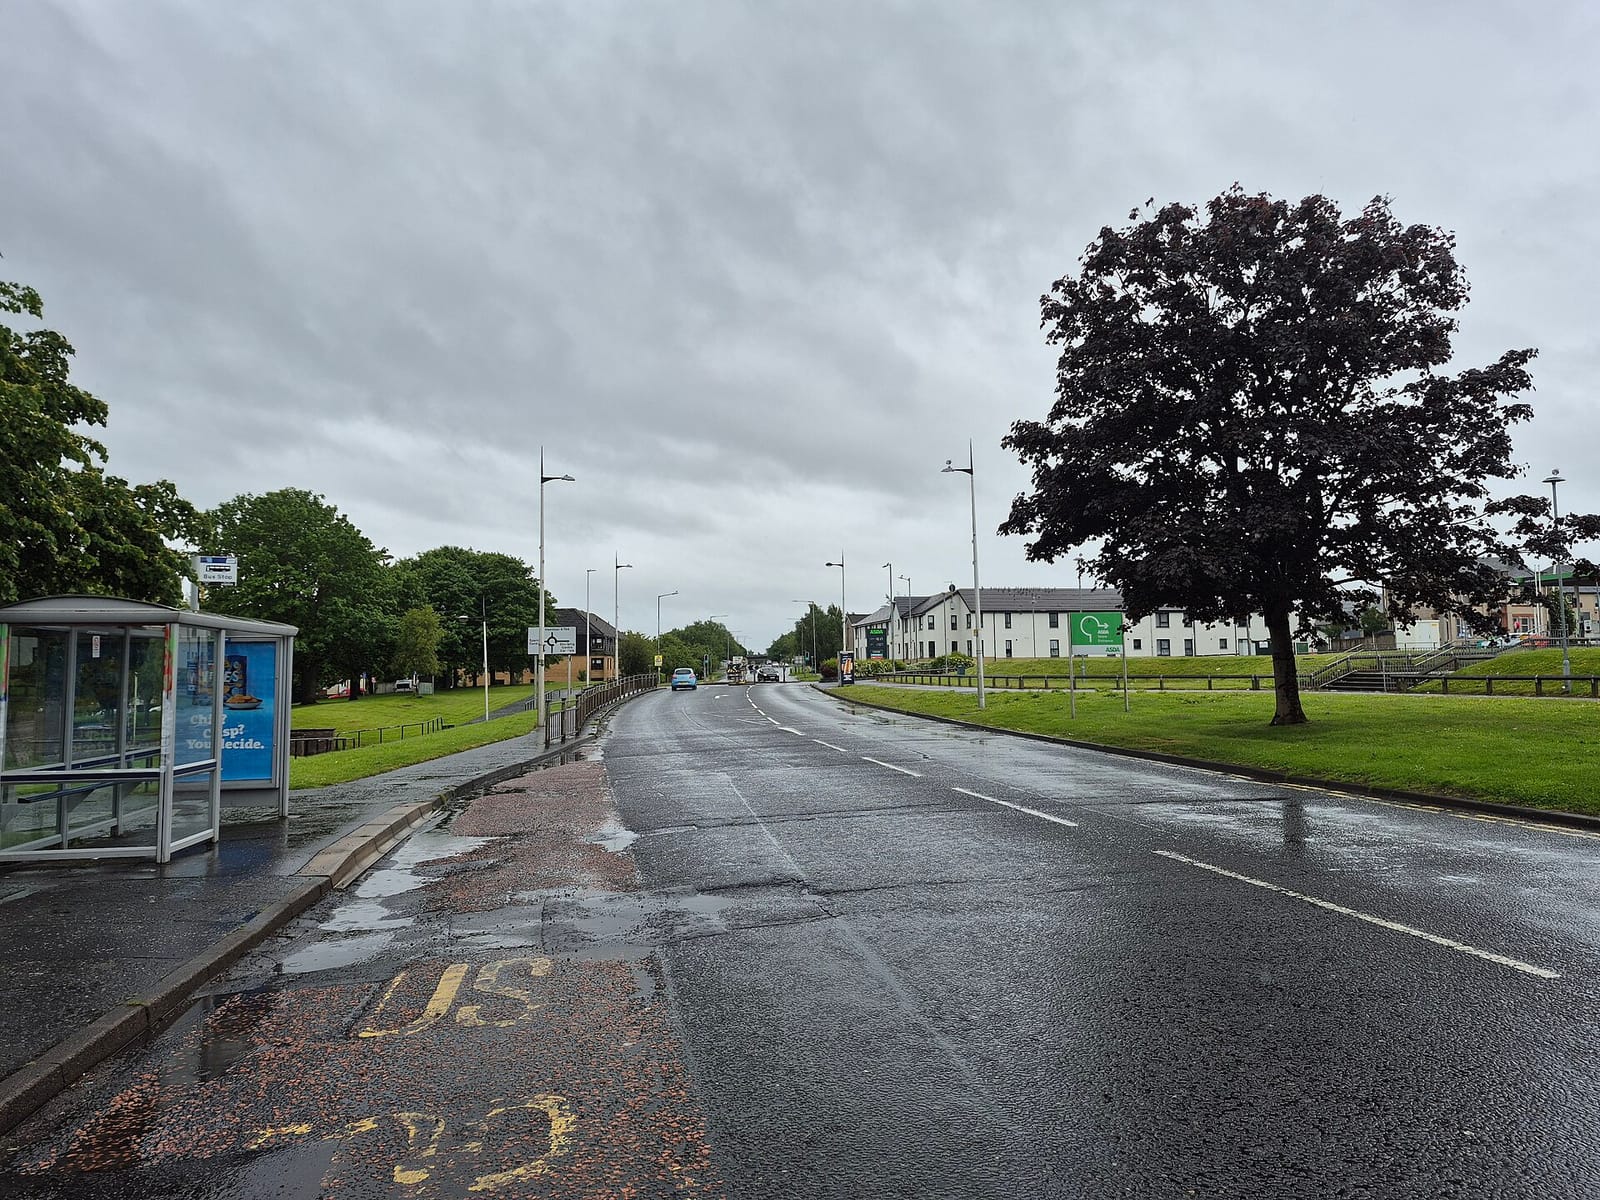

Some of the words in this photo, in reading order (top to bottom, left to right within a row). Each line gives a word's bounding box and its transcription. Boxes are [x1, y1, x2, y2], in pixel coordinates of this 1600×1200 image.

[190, 713, 228, 725] Chi?
[203, 724, 245, 739] Csp?
[186, 739, 213, 750] You
